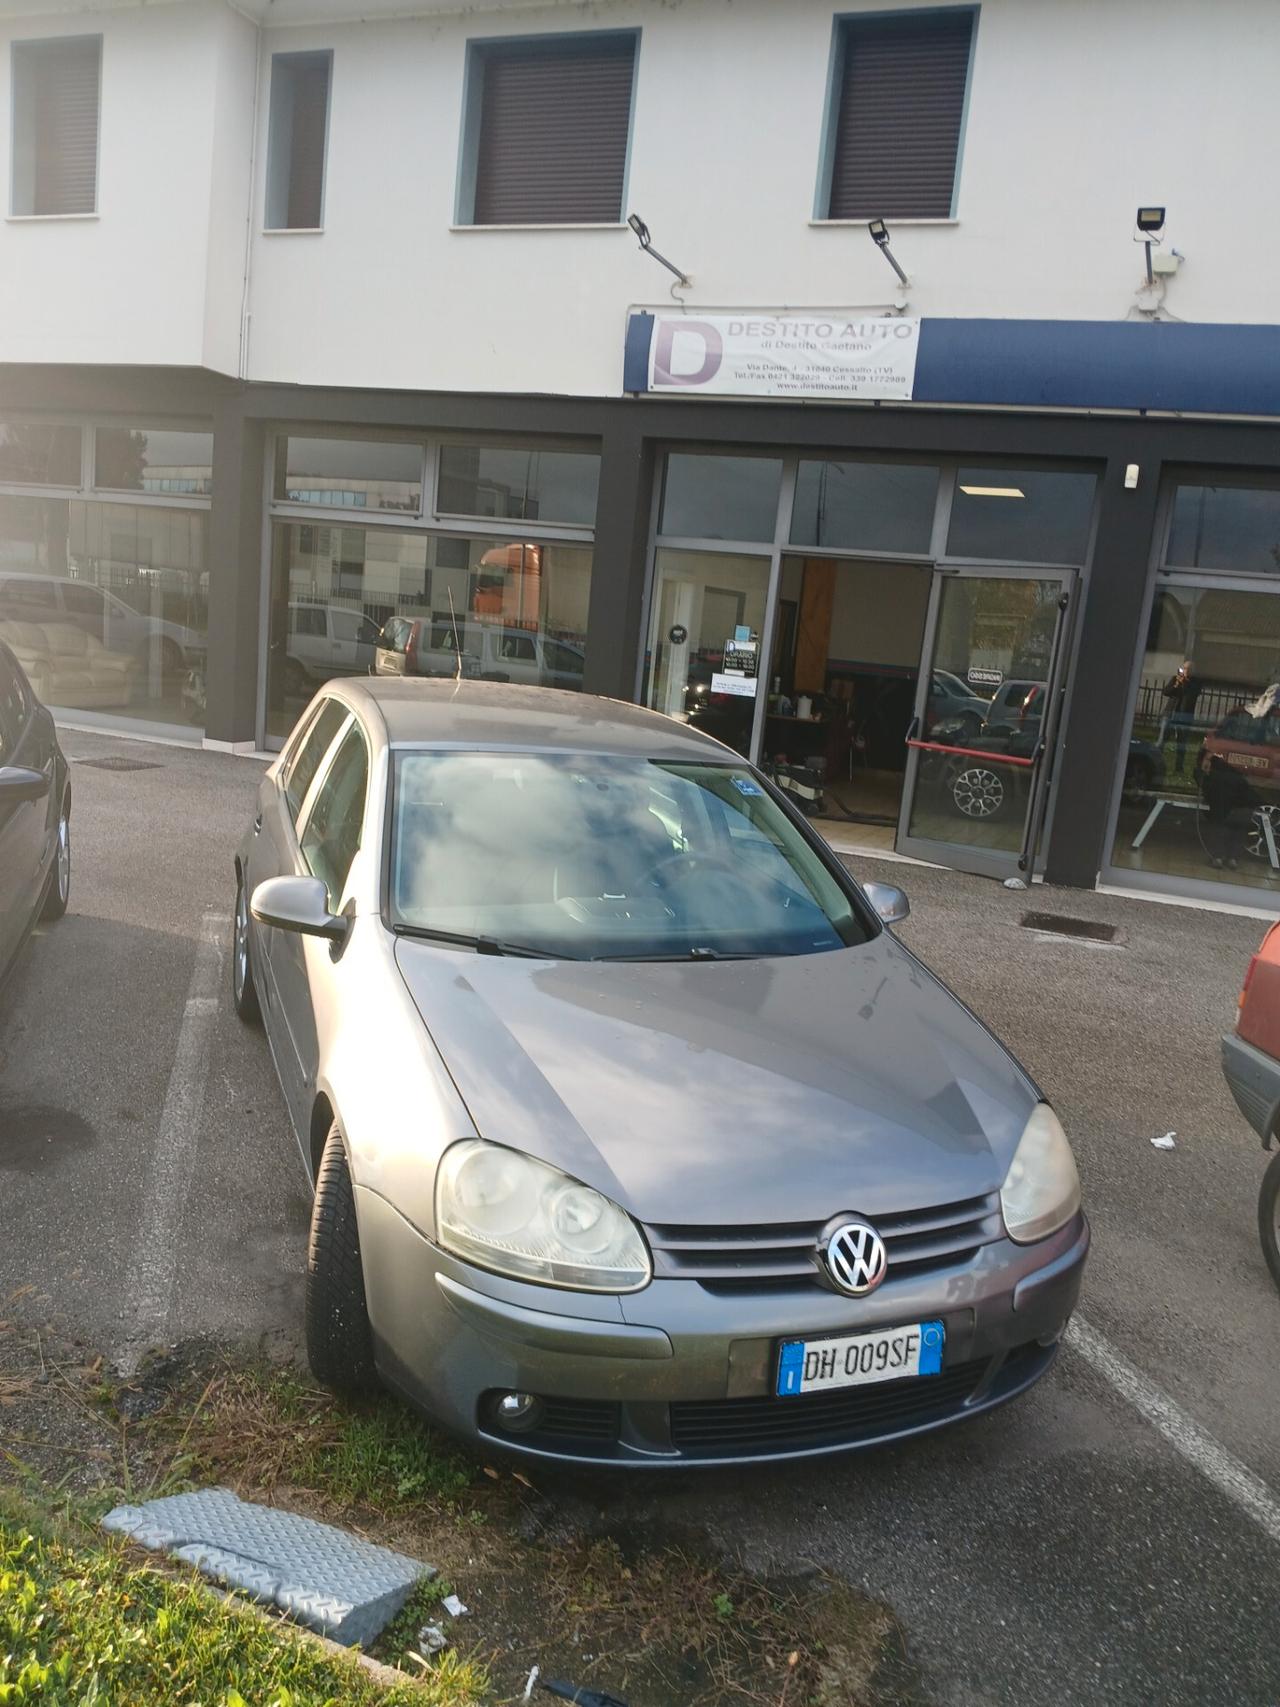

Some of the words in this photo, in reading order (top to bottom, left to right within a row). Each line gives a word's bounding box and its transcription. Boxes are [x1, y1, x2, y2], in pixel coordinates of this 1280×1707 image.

[728, 321, 833, 338] DESTITO
[839, 323, 912, 339] AUTO
[775, 341, 817, 350] Destito
[747, 363, 761, 371] Via
[777, 382, 858, 391] www.destitoauto.it
[804, 1348, 836, 1381] DH
[844, 1334, 919, 1376] 009SF
